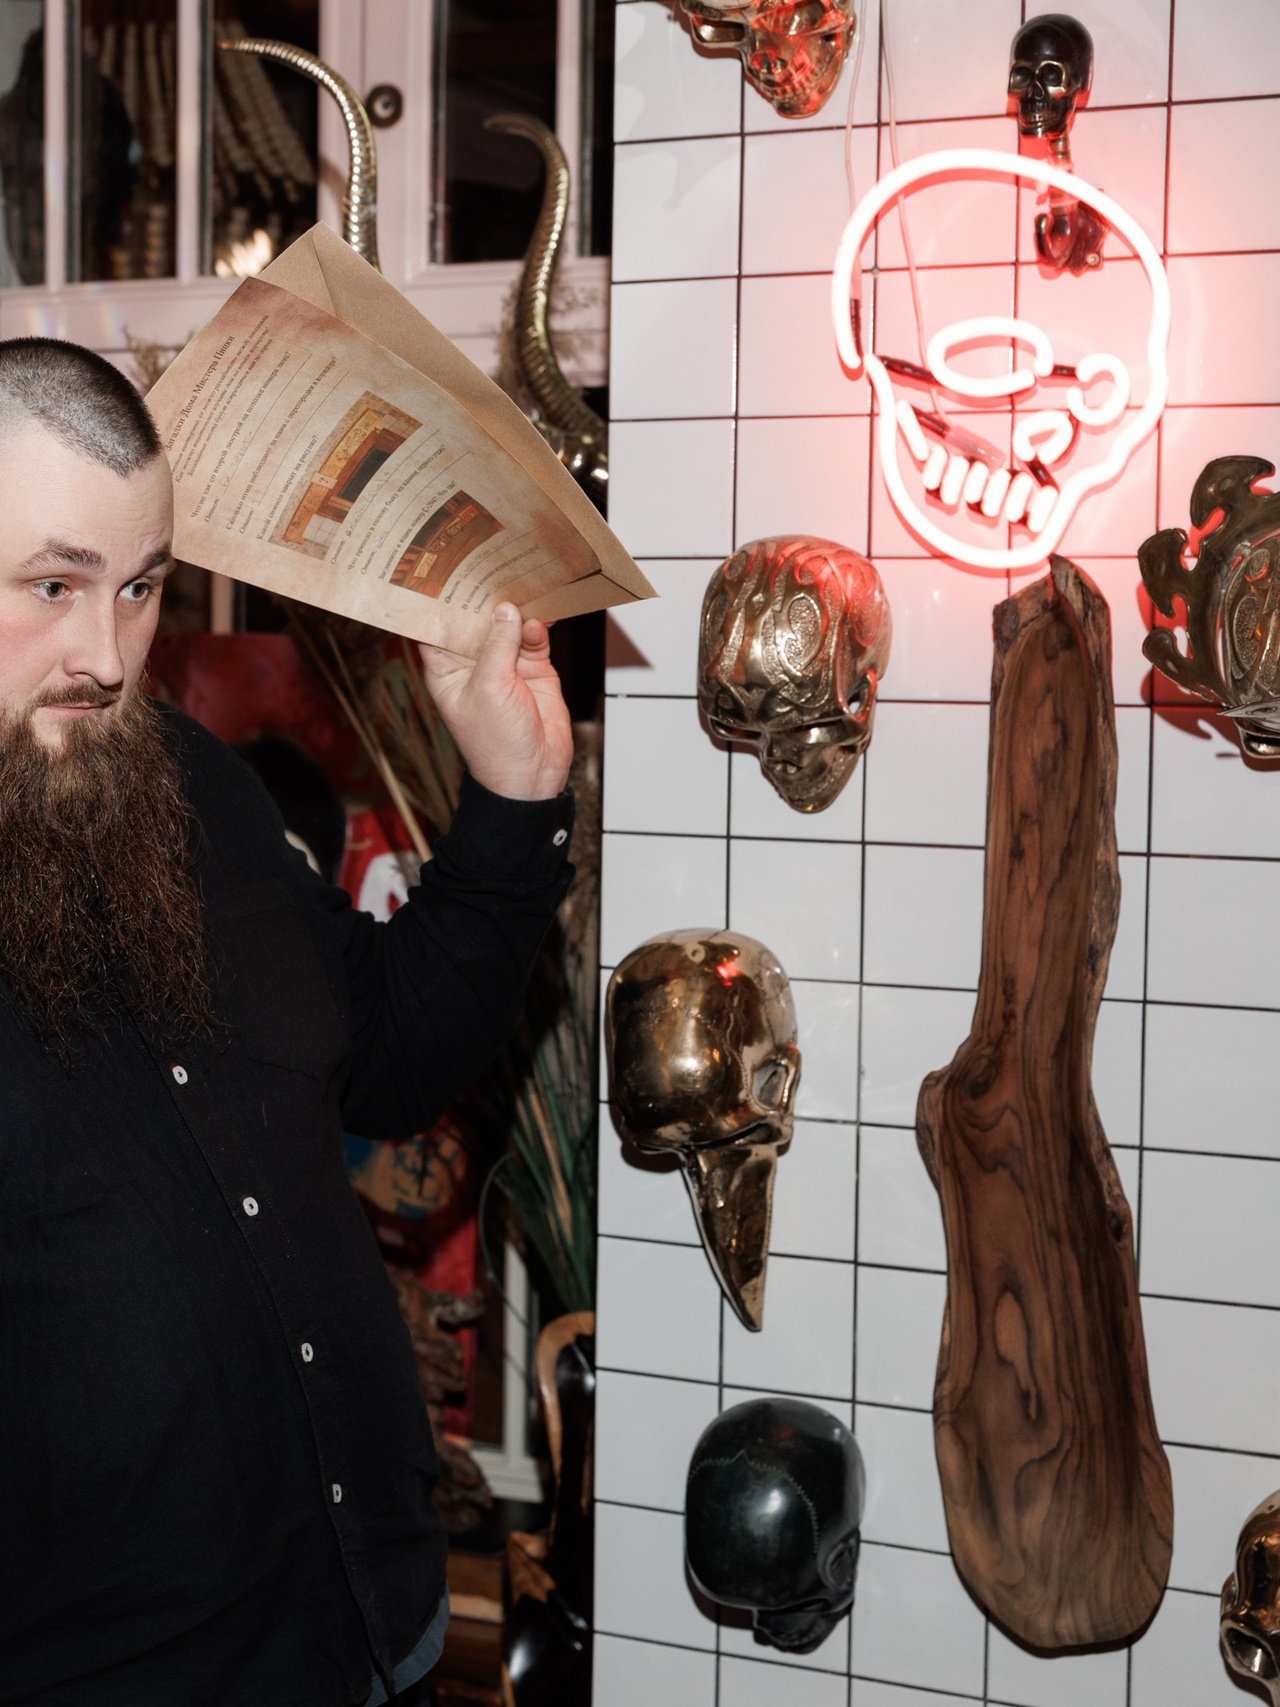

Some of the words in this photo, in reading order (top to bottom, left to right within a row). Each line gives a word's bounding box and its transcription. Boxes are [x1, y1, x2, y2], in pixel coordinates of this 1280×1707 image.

[163, 417, 186, 451] Загадки
[180, 394, 198, 418] Дома
[192, 359, 219, 394] Мистера
[202, 390, 216, 410] можно
[235, 338, 250, 357] между
[174, 470, 185, 483] Как
[182, 448, 195, 469] можно
[192, 411, 215, 448] тщательнее
[225, 376, 235, 389] дом
[232, 369, 239, 377] на
[190, 504, 202, 518] Что
[198, 495, 206, 504] не
[202, 483, 211, 495] так
[208, 473, 216, 483] со
[212, 449, 229, 474] второй
[224, 420, 245, 450] люстрой
[240, 412, 248, 421] на
[246, 388, 264, 413] потолке
[261, 368, 279, 389] номера
[205, 422, 217, 442] места
[214, 404, 229, 423] будут
[225, 500, 244, 530] Сколько
[240, 483, 253, 500] птиц
[249, 446, 273, 484] наблюдают
[269, 438, 277, 446] за
[287, 384, 315, 419] перегородки
[203, 496, 221, 523] Ответ:
[238, 508, 255, 534] Ответ:
[256, 518, 272, 540] Какой
[268, 493, 284, 518] символ
[281, 471, 297, 493] закрыт
[293, 462, 302, 471] на
[298, 434, 320, 464] рисунке?
[329, 539, 347, 564] Ответ:
[346, 556, 358, 571] Что
[355, 530, 373, 557] пришло
[371, 506, 389, 527] голову
[384, 492, 400, 507] быку
[396, 485, 404, 493] на
[360, 550, 377, 575] Ответ:
[378, 547, 399, 581] Загляните
[410, 511, 426, 528] номер
